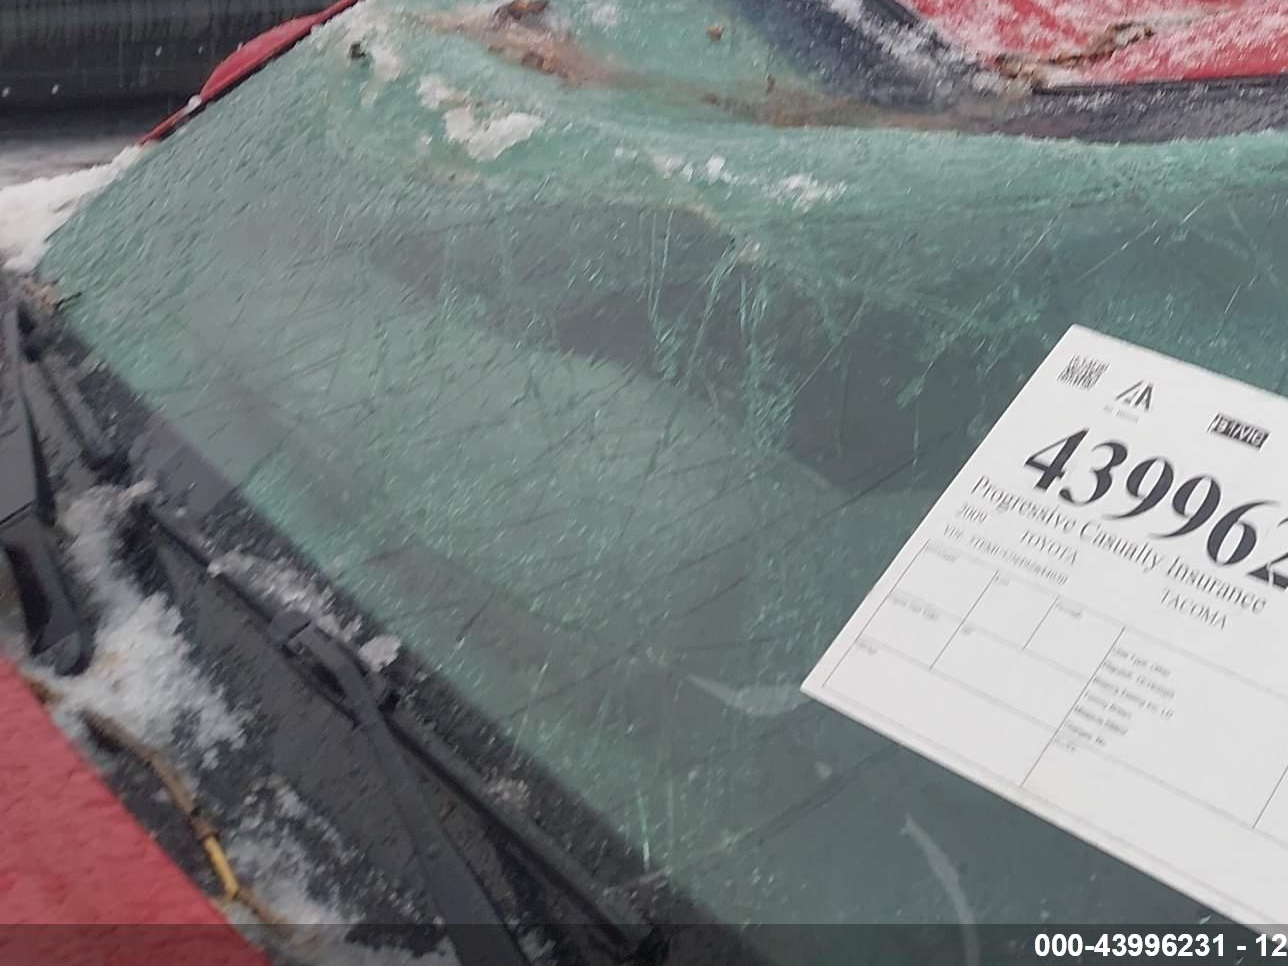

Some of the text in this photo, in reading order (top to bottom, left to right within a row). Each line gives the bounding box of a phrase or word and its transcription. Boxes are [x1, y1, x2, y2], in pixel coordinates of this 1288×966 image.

[971, 475, 1077, 533] Progressive
[1079, 520, 1164, 572] Casualty
[1166, 555, 1267, 613] Insurance
[1020, 529, 1078, 566] TOYOTA
[1160, 587, 1228, 631] TACOMA
